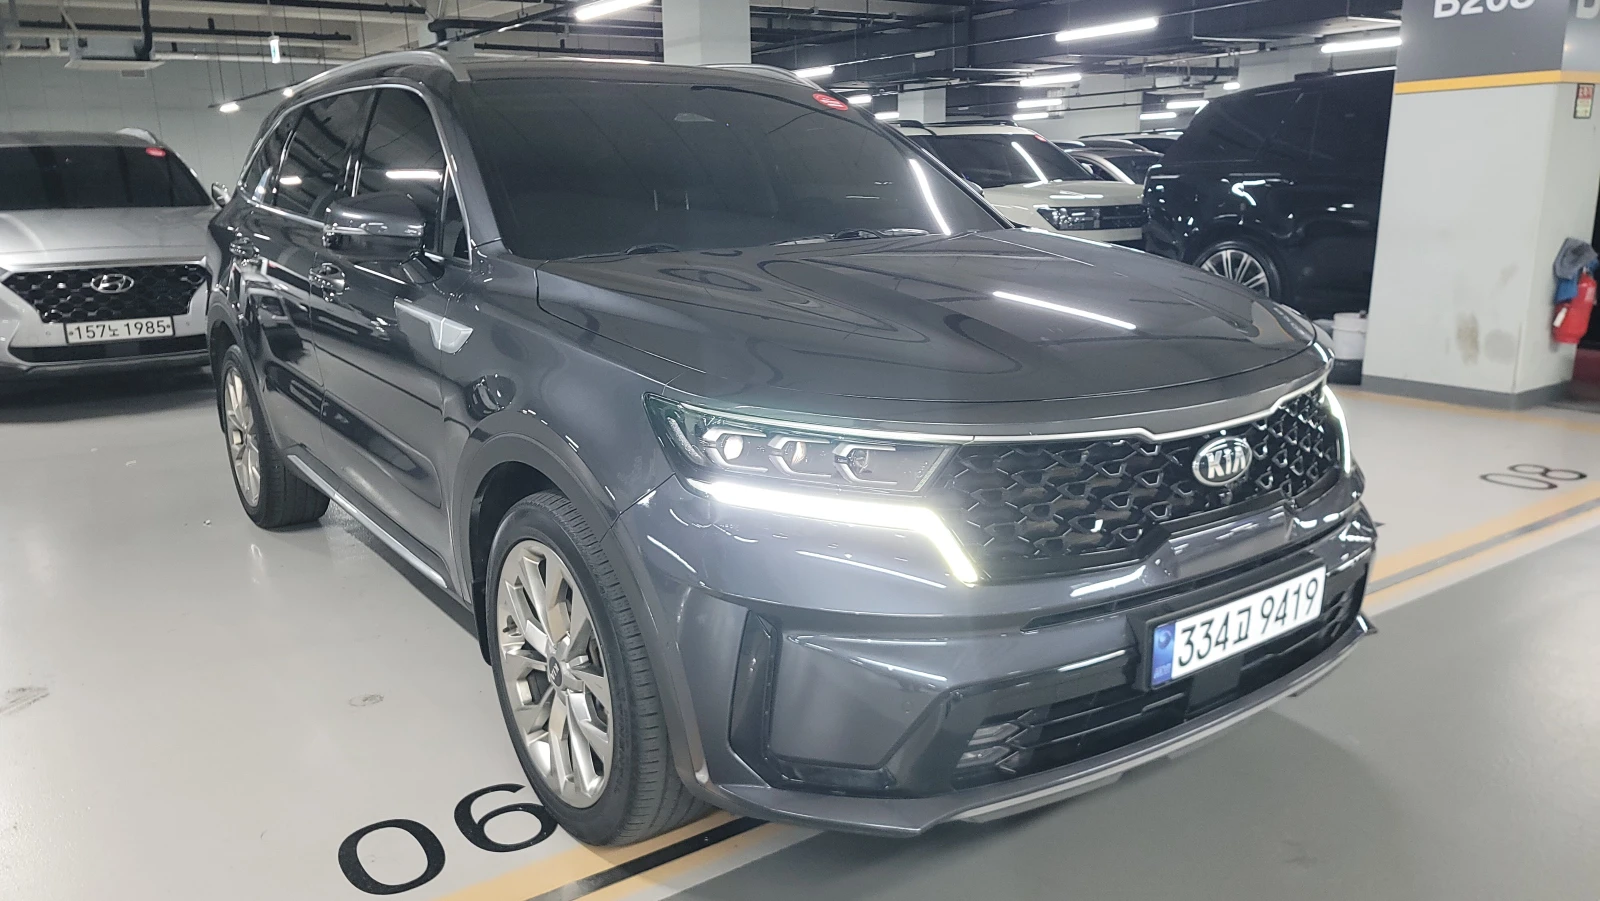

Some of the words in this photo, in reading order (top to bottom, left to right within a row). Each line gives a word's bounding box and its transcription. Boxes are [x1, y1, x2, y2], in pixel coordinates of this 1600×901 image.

[75, 324, 119, 340] 157노
[124, 320, 166, 336] 1985
[1205, 446, 1247, 479] KIA
[1479, 463, 1588, 490] 08
[1178, 605, 1252, 667] 334고
[1260, 577, 1318, 634] 9419
[338, 783, 559, 896] 06
